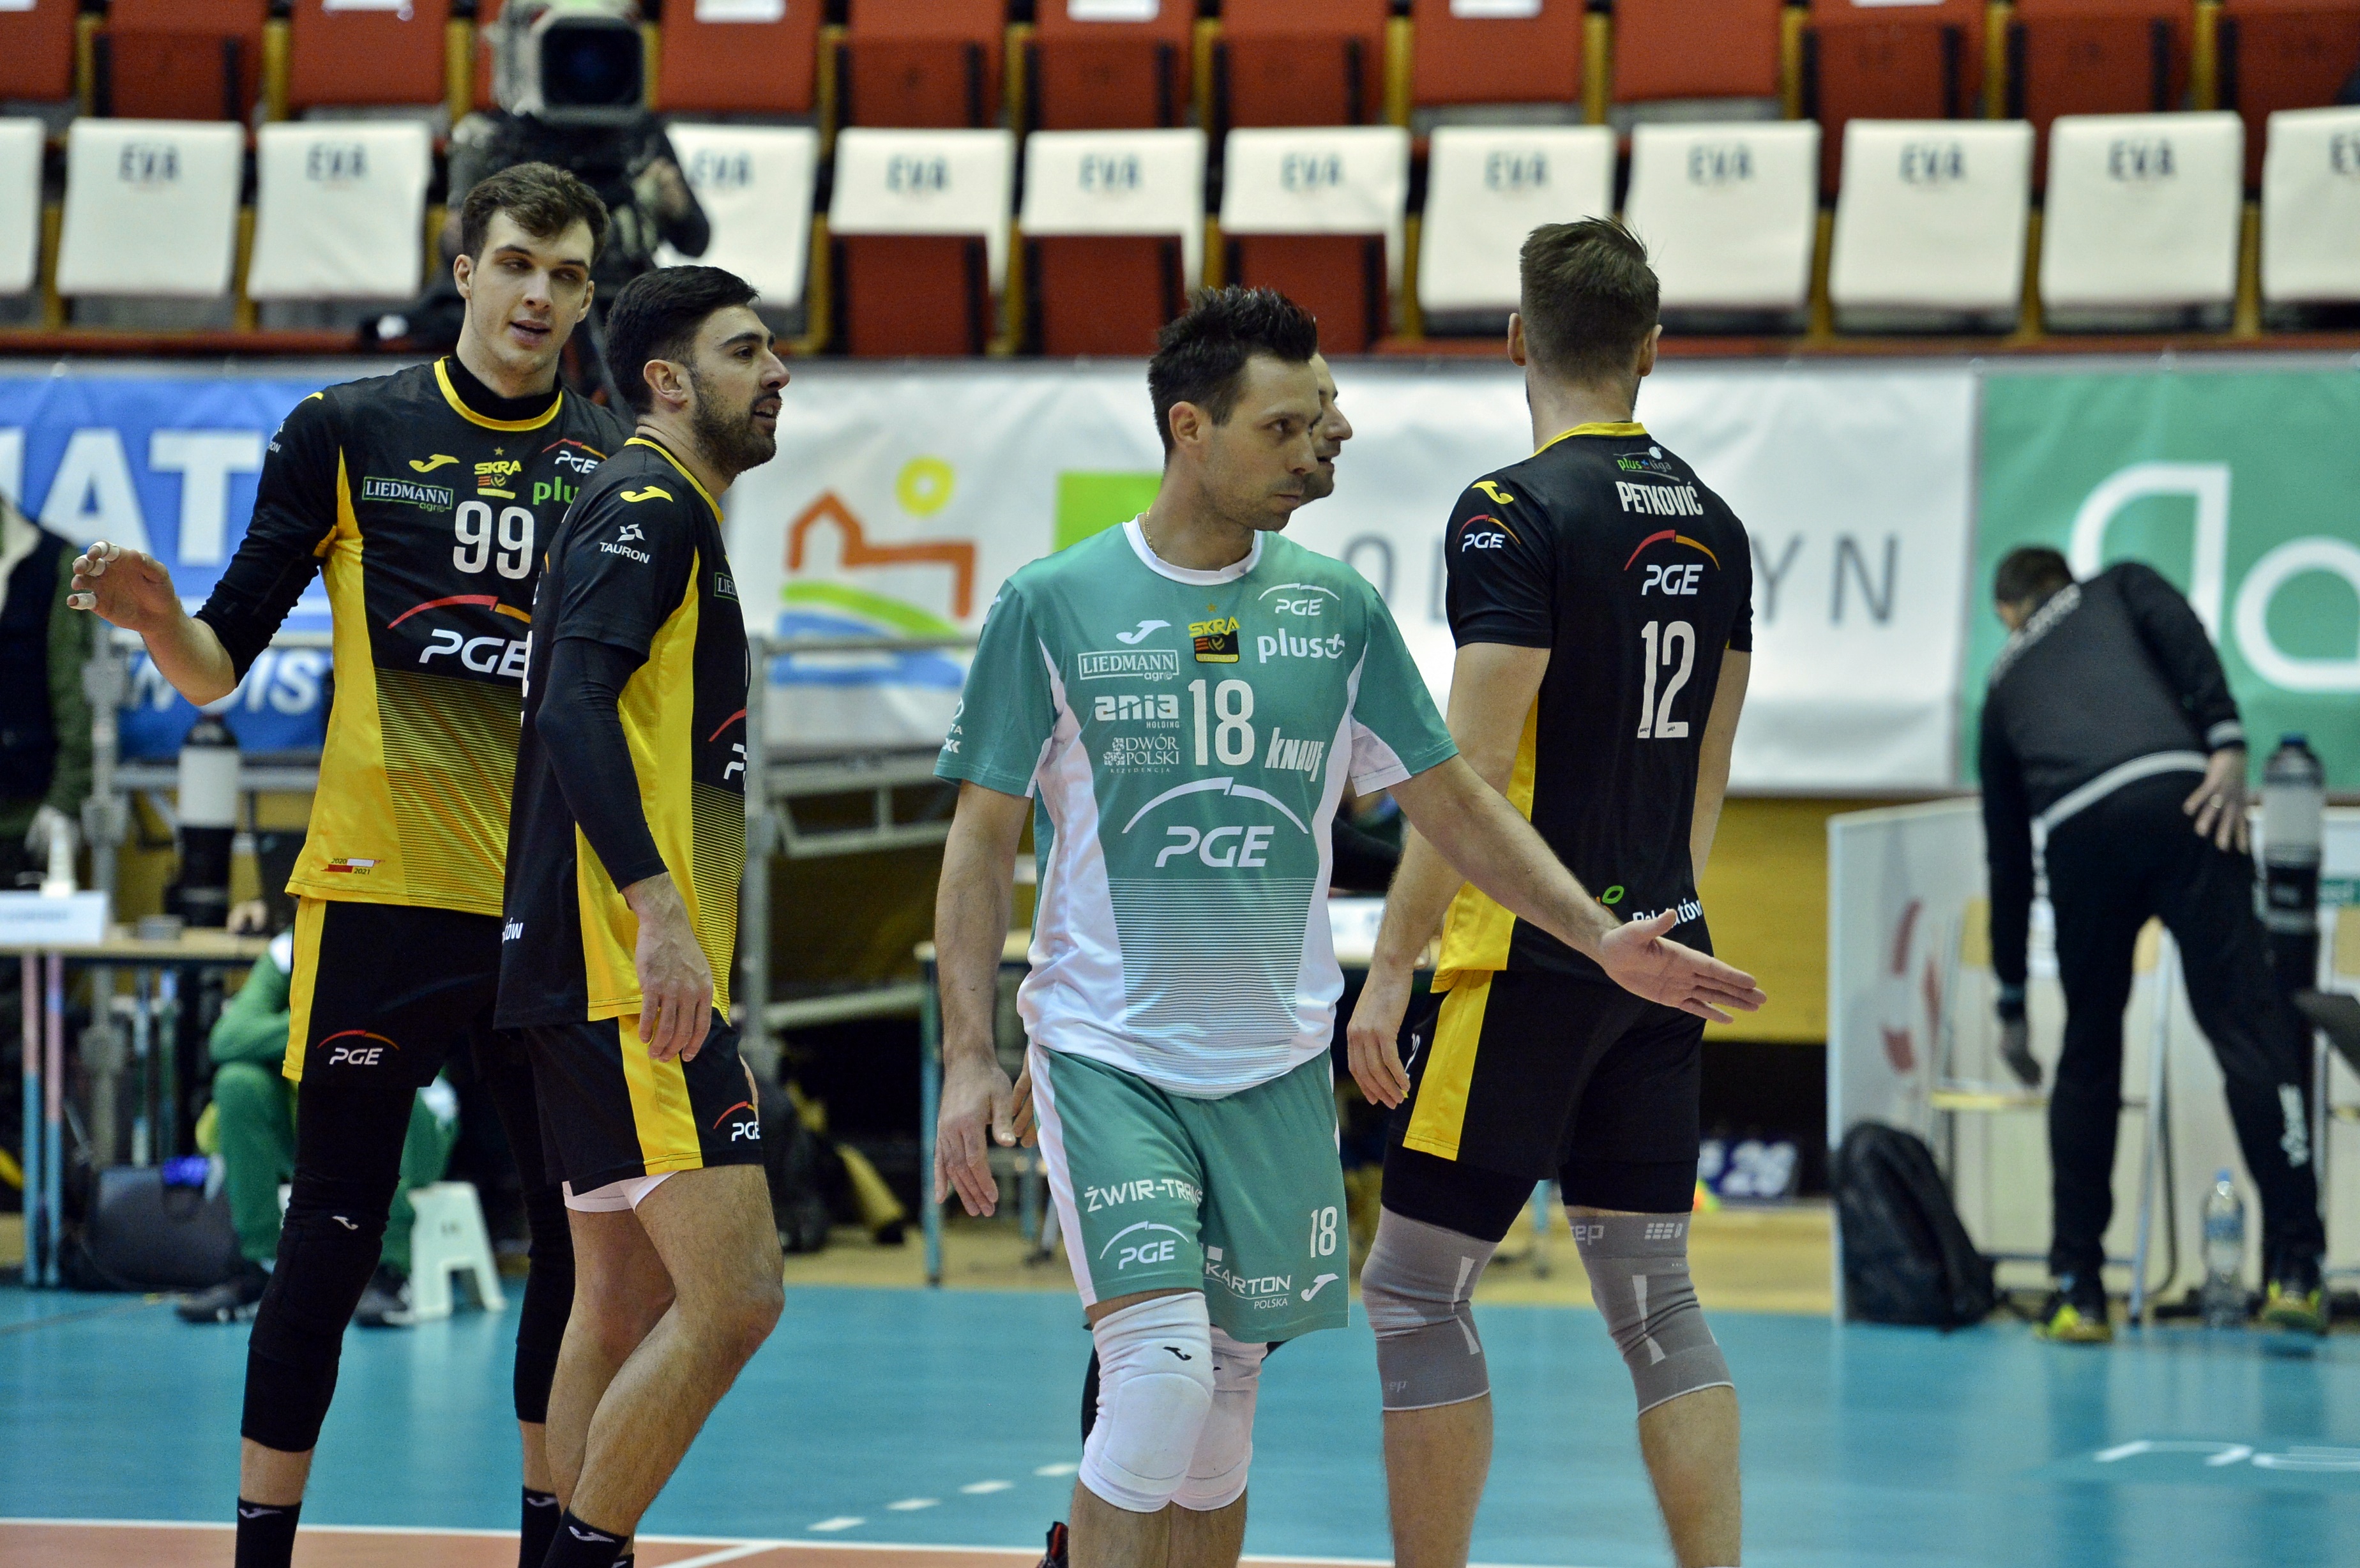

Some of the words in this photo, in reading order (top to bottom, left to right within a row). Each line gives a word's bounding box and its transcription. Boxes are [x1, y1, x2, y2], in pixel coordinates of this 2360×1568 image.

[119, 144, 181, 181] EVA
[308, 142, 369, 180] EVA
[886, 156, 950, 192] EVA
[1079, 155, 1141, 190] EVA
[1281, 153, 1342, 190] EVA
[1485, 152, 1548, 190] EVA
[1690, 146, 1753, 184] EVA
[1900, 143, 1967, 183] EVA
[2109, 141, 2177, 181] EVA
[474, 460, 522, 475] SKRA
[555, 450, 598, 474] PGE
[366, 481, 449, 504] LIEDMANN
[533, 476, 580, 505] plu
[1615, 481, 1704, 515] PETKOVIĆ
[453, 501, 534, 580] 99
[600, 542, 650, 564] TAURON
[1462, 532, 1506, 552] PGE
[1641, 565, 1704, 596] PGE
[1275, 598, 1323, 616] PGE
[1188, 616, 1241, 637] SKRA
[418, 629, 529, 678] PGE
[1082, 654, 1174, 674] LIEDMANN
[1637, 621, 1696, 739] 12
[1094, 694, 1179, 721] ania
[1188, 679, 1255, 766] 18
[1146, 721, 1180, 729] HOLDING
[1126, 734, 1180, 751] DWÓR
[1126, 750, 1180, 766] POLSKI
[1154, 825, 1275, 868] PGE
[328, 1048, 384, 1066] PGE
[1310, 1205, 1338, 1258] 18
[1118, 1240, 1176, 1270] PGE
[1253, 1298, 1288, 1309] POLSKA
